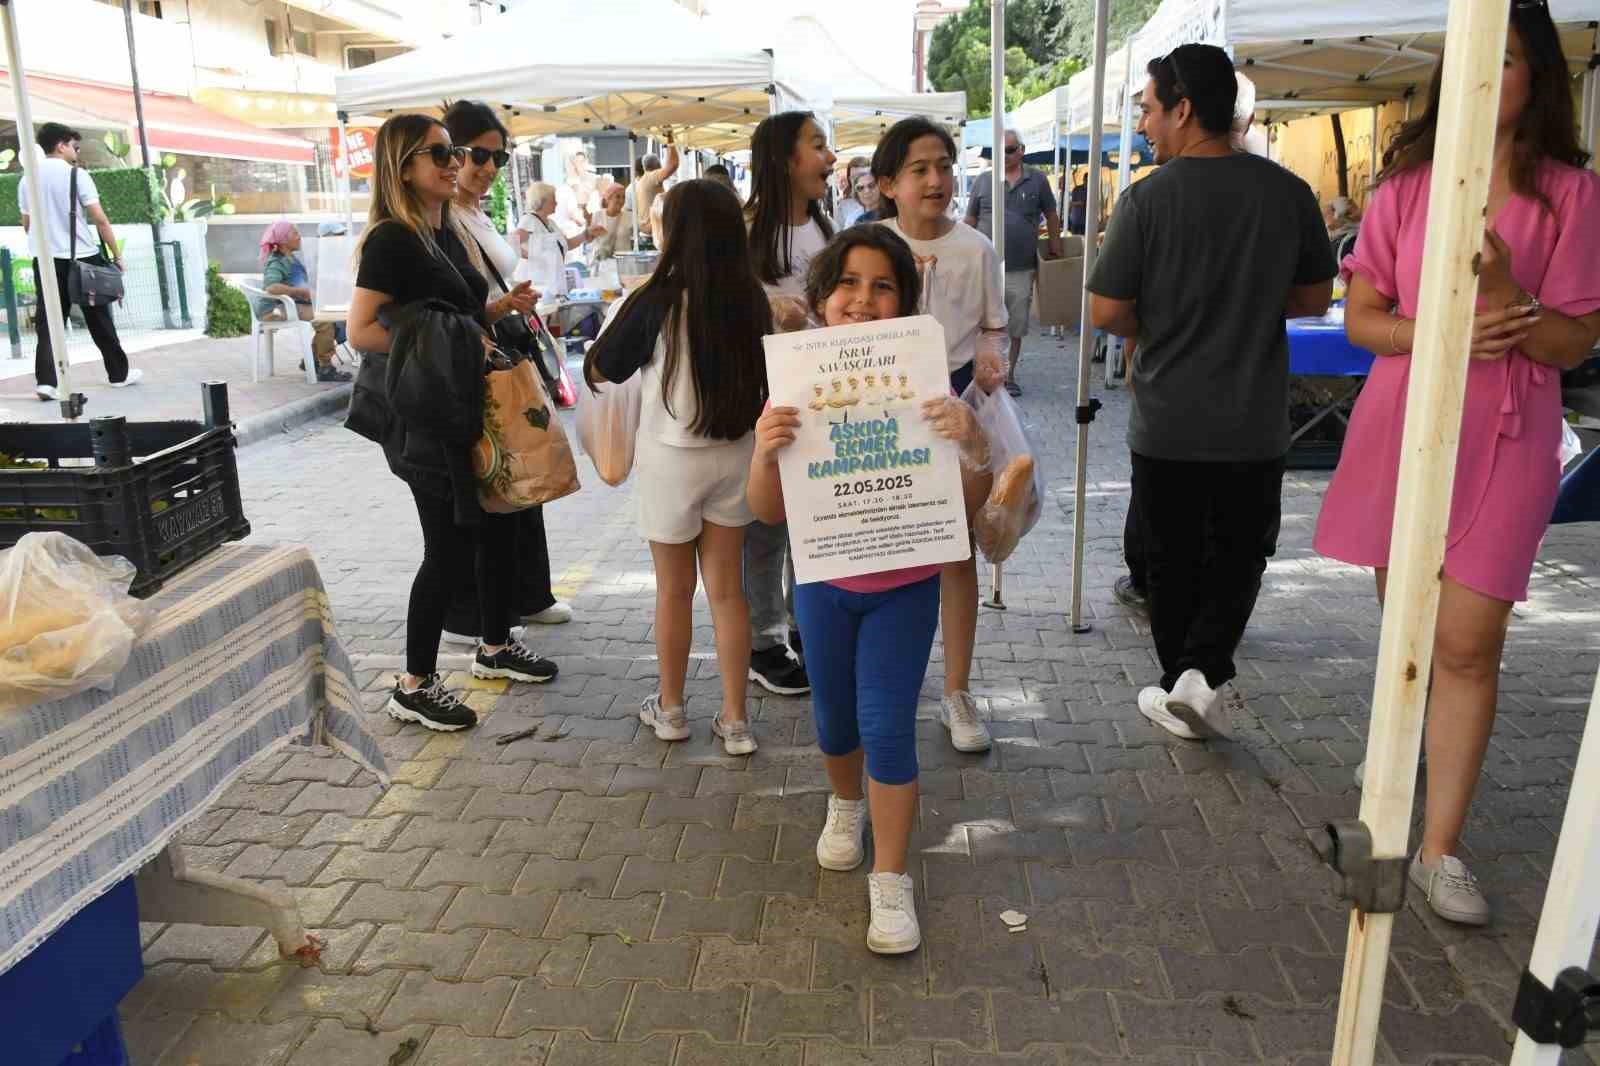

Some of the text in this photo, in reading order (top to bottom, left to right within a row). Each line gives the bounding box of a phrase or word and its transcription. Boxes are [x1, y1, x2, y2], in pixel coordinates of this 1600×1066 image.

[817, 354, 897, 374] SAVAŞÇILARI
[838, 345, 876, 360] İSRAF
[829, 418, 899, 442] ASKIDA
[834, 435, 898, 459] EKMEK
[807, 447, 931, 480] KAMPANYASI
[833, 474, 913, 497] 22.05.2025
